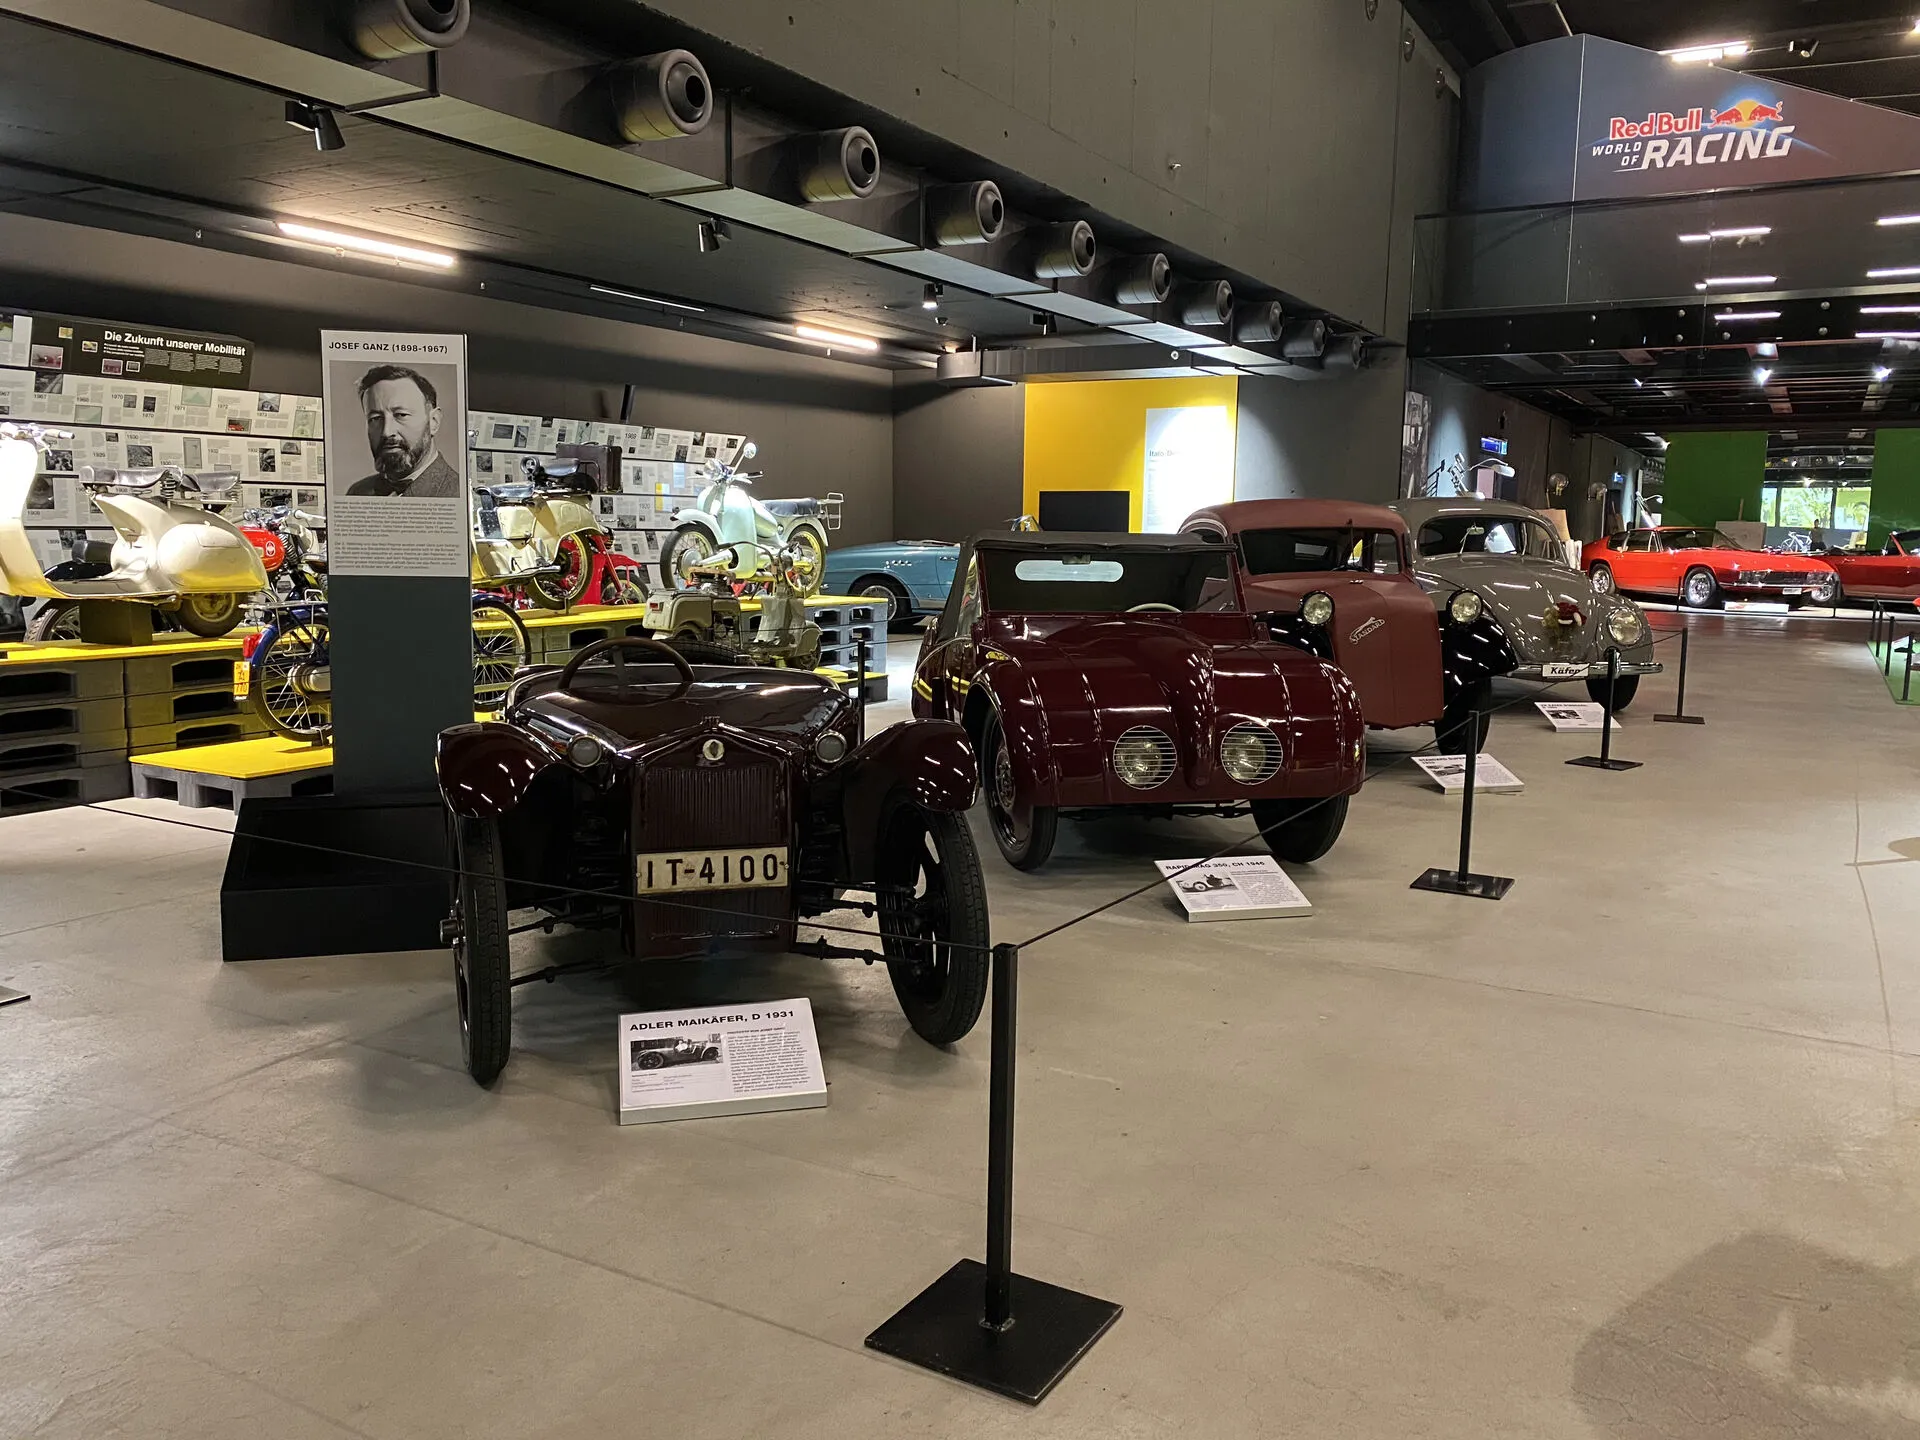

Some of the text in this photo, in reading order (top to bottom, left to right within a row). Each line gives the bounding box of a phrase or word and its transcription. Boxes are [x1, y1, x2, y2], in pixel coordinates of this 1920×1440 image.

[1609, 108, 1703, 140] Red Bull
[1592, 141, 1642, 157] WORLD
[1641, 126, 1796, 169] RACING
[1620, 154, 1640, 166] OF
[104, 330, 246, 356] Die Zukunft unserer Mobilität
[328, 341, 448, 354] JOSEF GANZ (1898-1967)
[629, 1020, 674, 1032] ADLER
[677, 1014, 748, 1027] MAIKÄFER,
[765, 1010, 795, 1019] 1931
